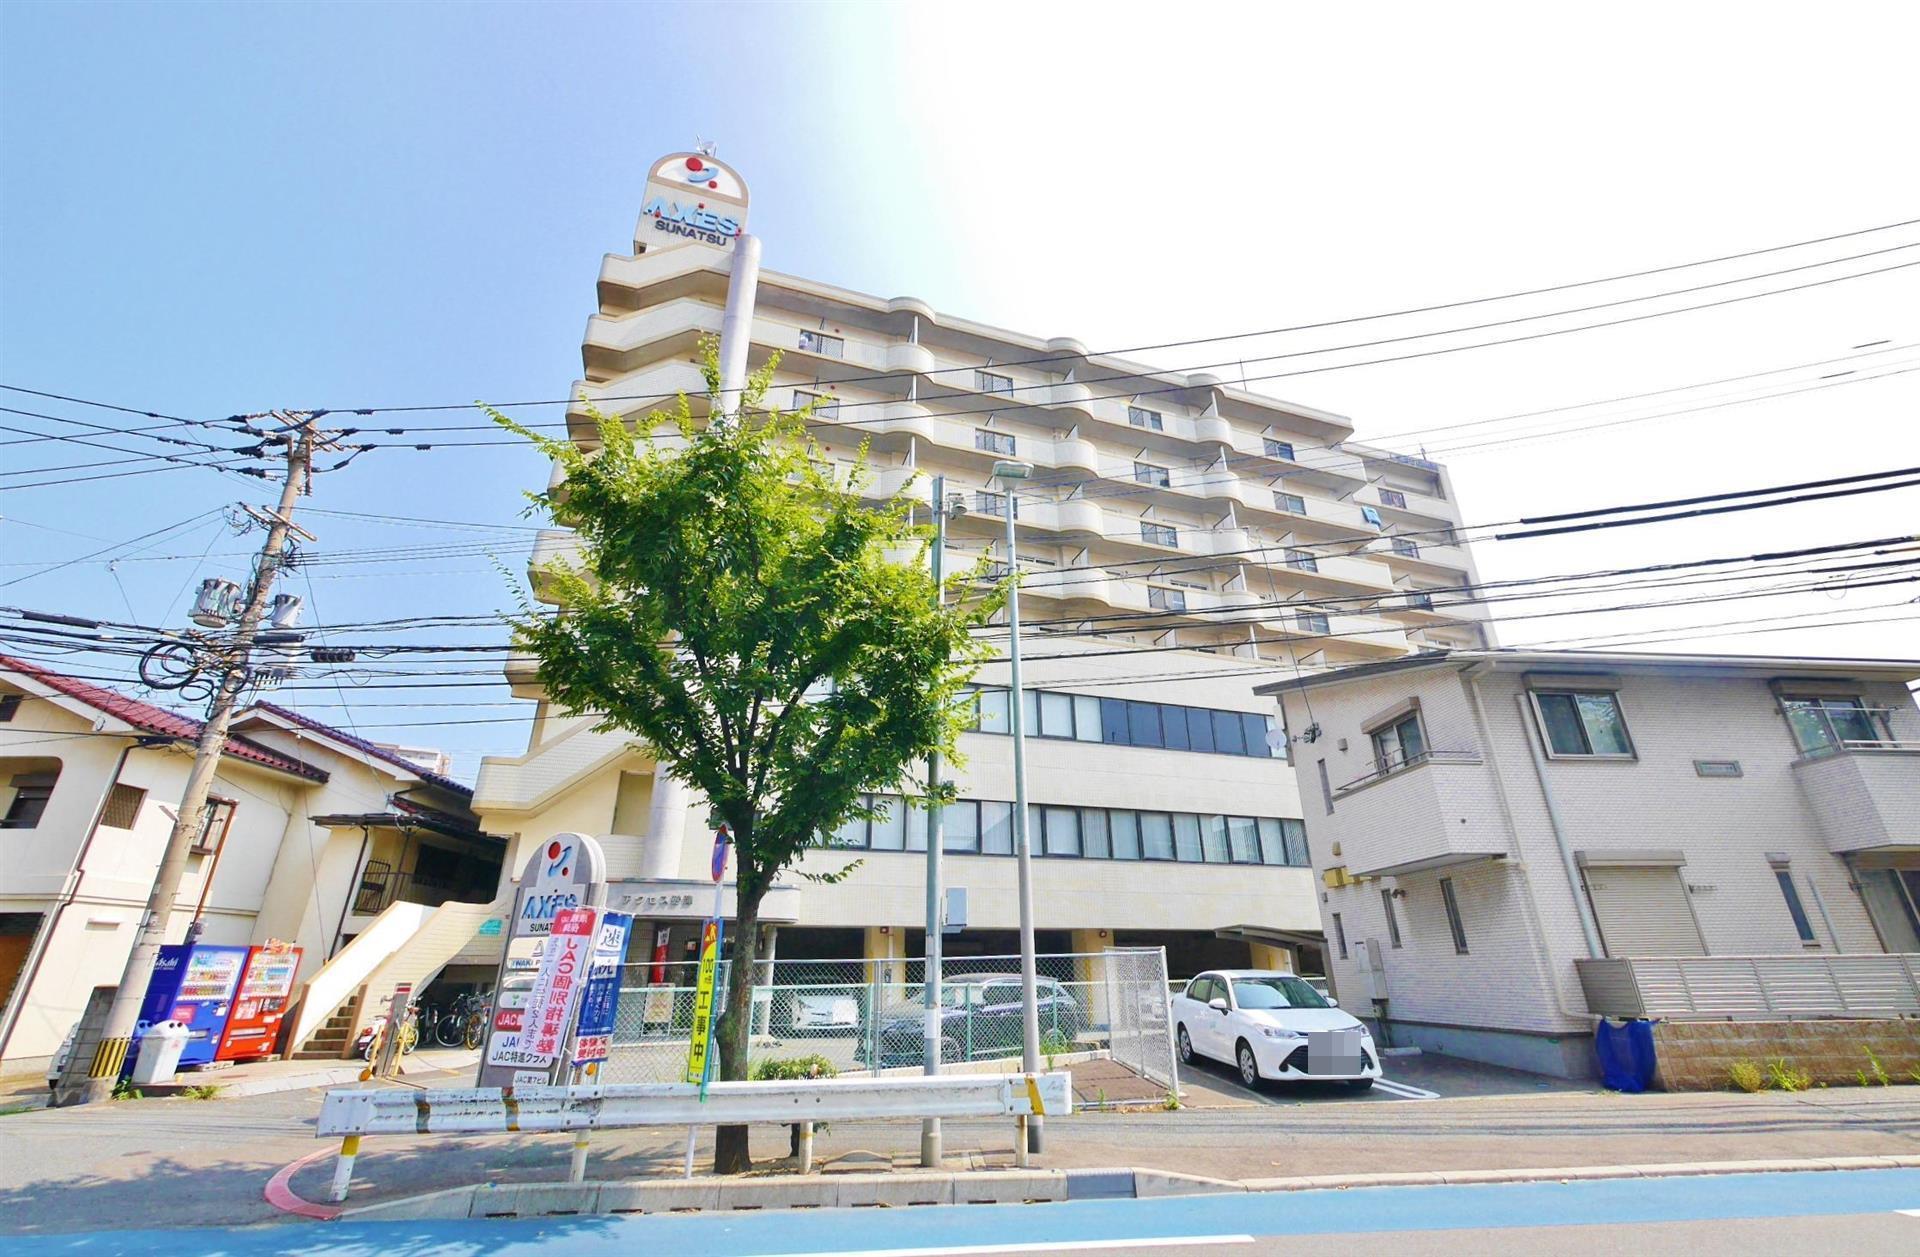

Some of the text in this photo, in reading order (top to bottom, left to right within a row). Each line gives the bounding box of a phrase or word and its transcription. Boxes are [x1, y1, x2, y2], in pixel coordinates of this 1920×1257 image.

[655, 220, 728, 246] SUNATSU
[530, 923, 553, 932] SUNAT
[498, 1014, 520, 1026] JAC
[693, 991, 709, 1062] 工事中
[502, 1036, 519, 1048] JA
